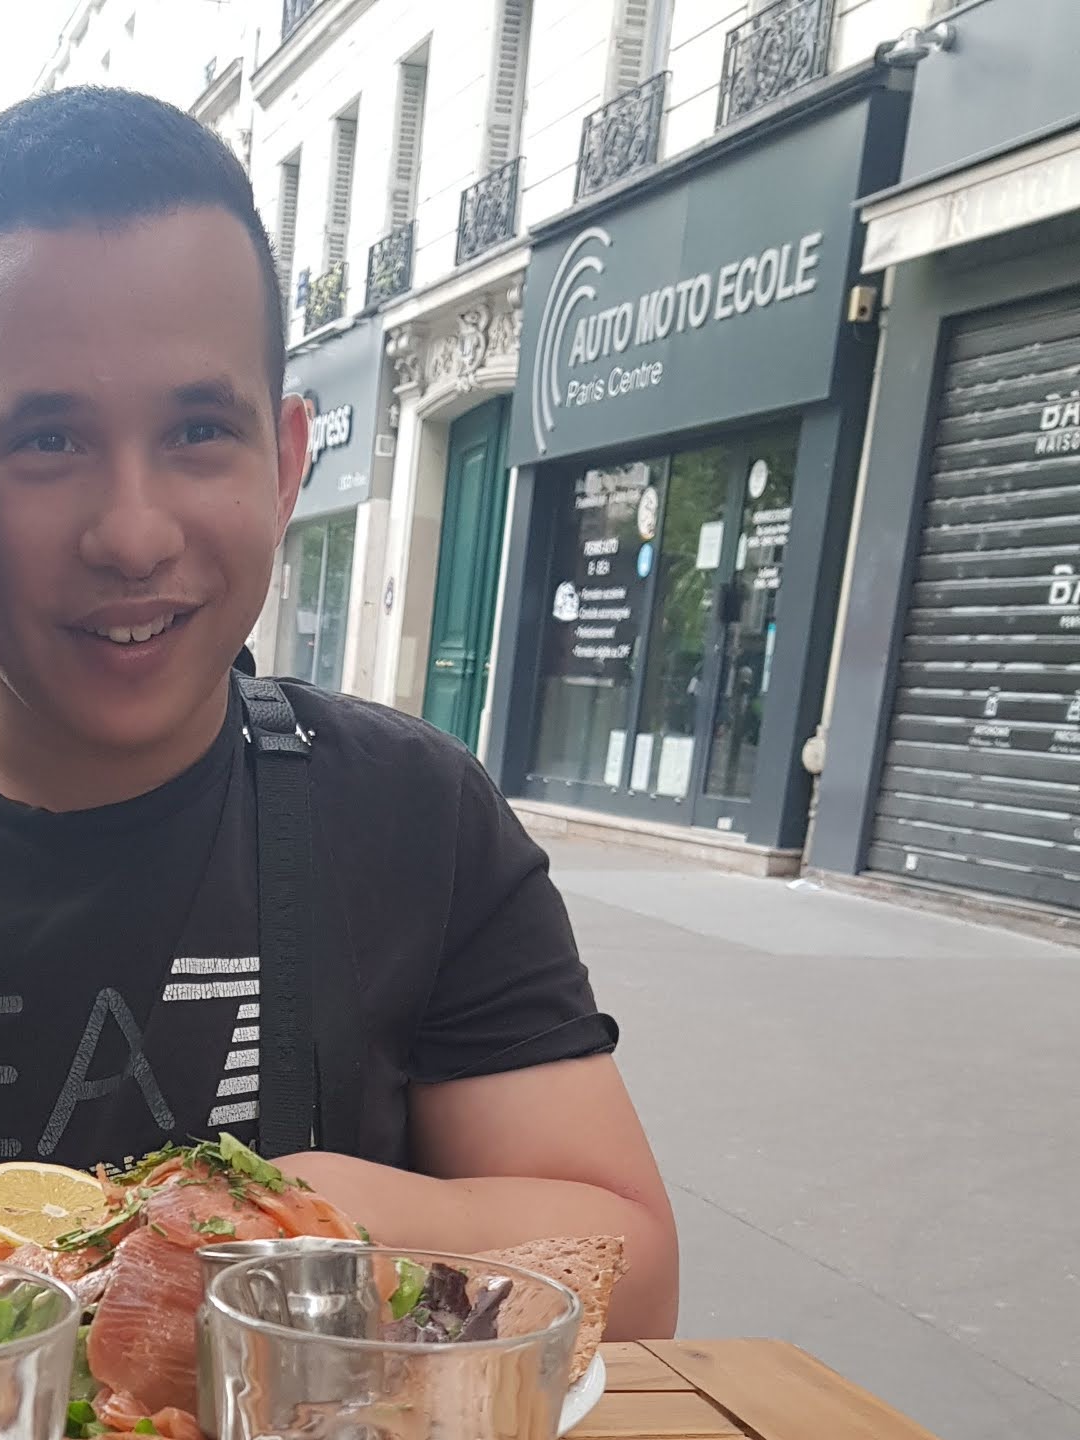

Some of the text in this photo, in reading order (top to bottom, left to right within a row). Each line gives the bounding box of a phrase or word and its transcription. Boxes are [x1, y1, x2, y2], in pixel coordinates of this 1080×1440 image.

[568, 232, 823, 367] AUTO MOTO ECOLE
[566, 361, 663, 407] Paris Centre
